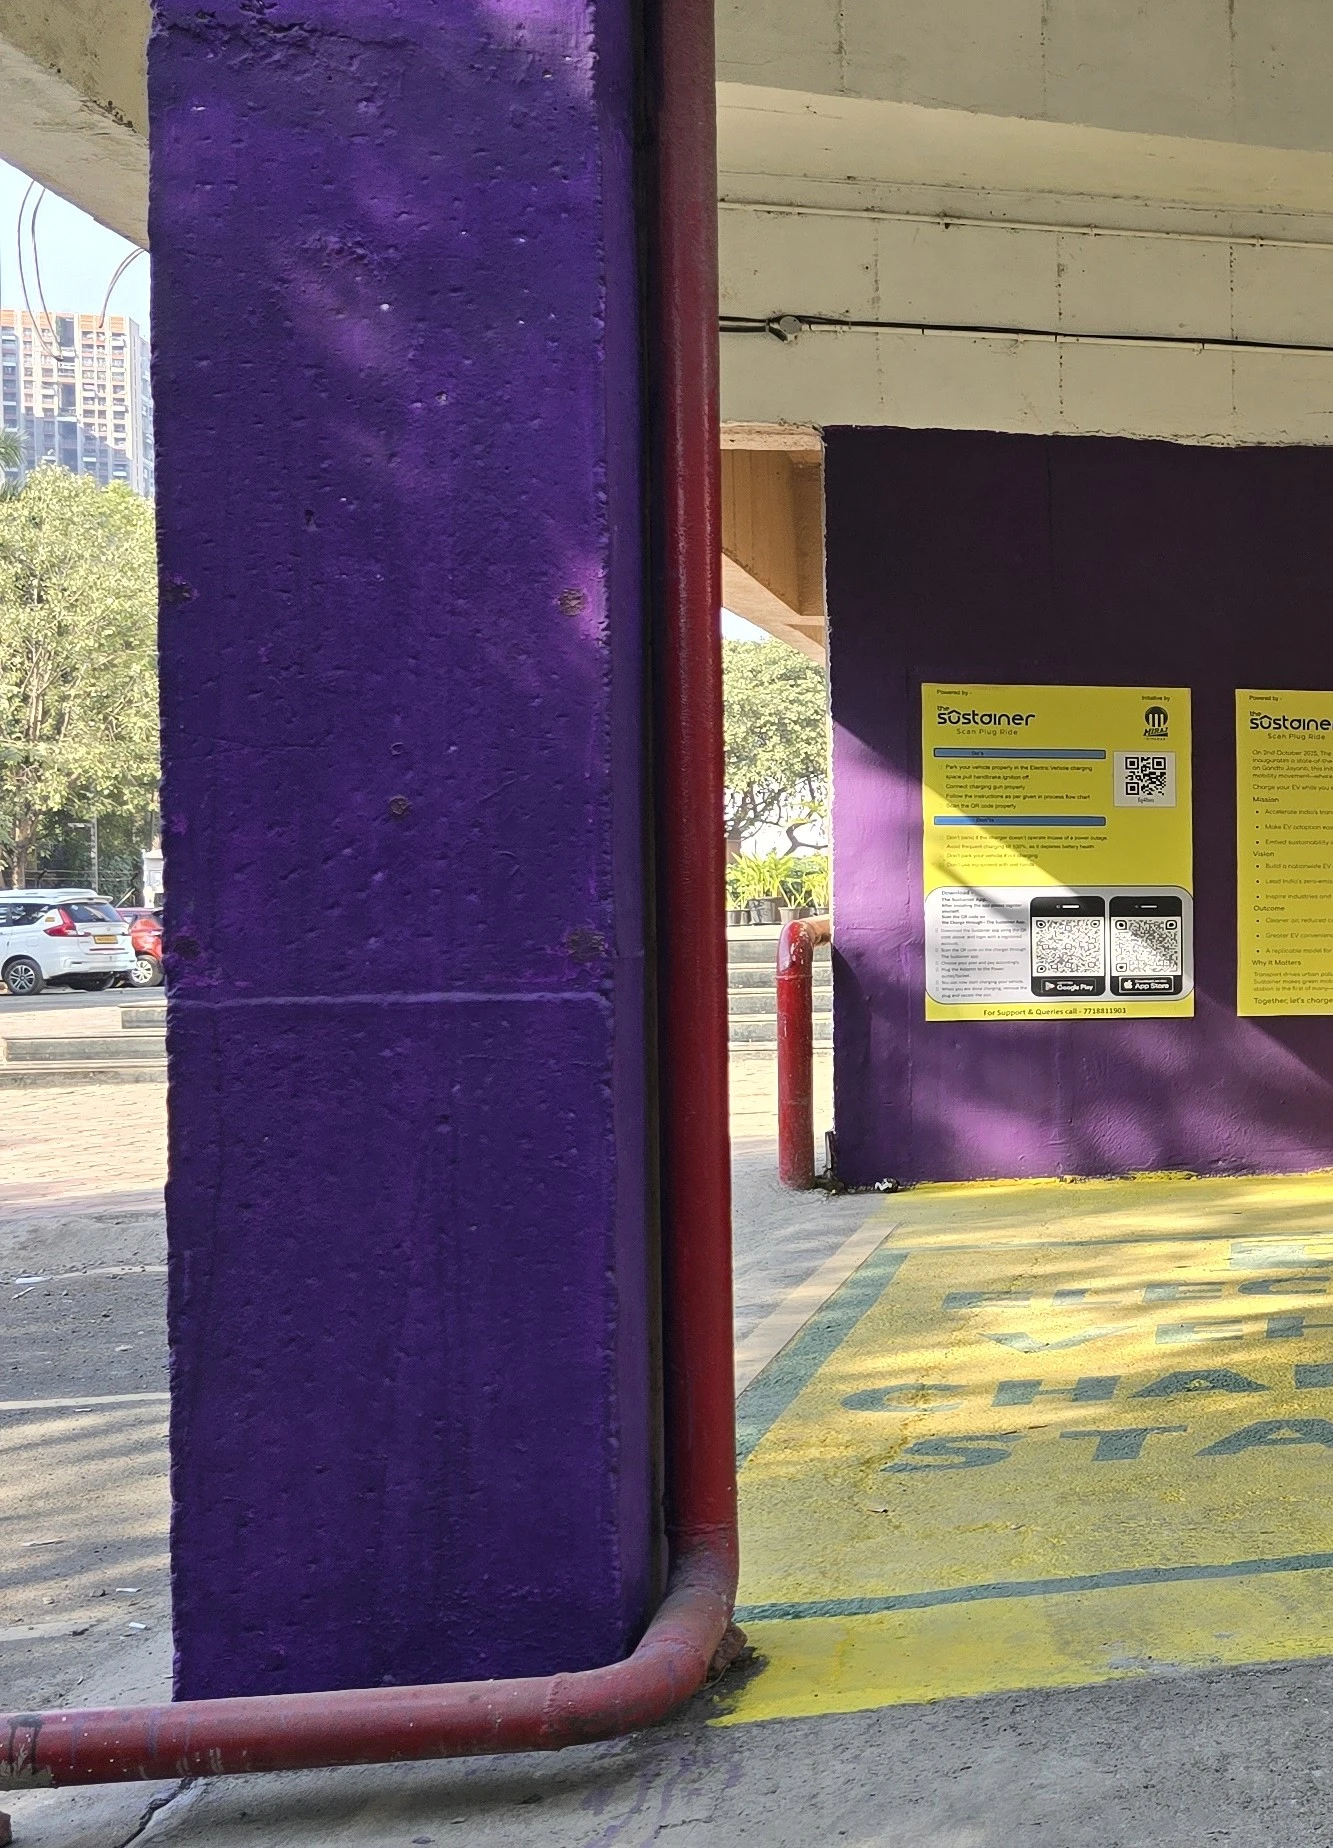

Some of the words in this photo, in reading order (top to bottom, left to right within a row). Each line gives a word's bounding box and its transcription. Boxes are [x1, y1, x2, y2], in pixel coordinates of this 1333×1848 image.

[979, 728, 997, 737] Plug
[1288, 733, 1306, 742] Plug
[1254, 997, 1288, 1006] Together,
[1306, 997, 1333, 1005] charge
[983, 1008, 995, 1017] For
[997, 1008, 1026, 1018] Support
[1036, 1007, 1064, 1016] Queries
[1065, 1007, 1077, 1015] call
[1084, 1006, 1126, 1014] 7718811903
